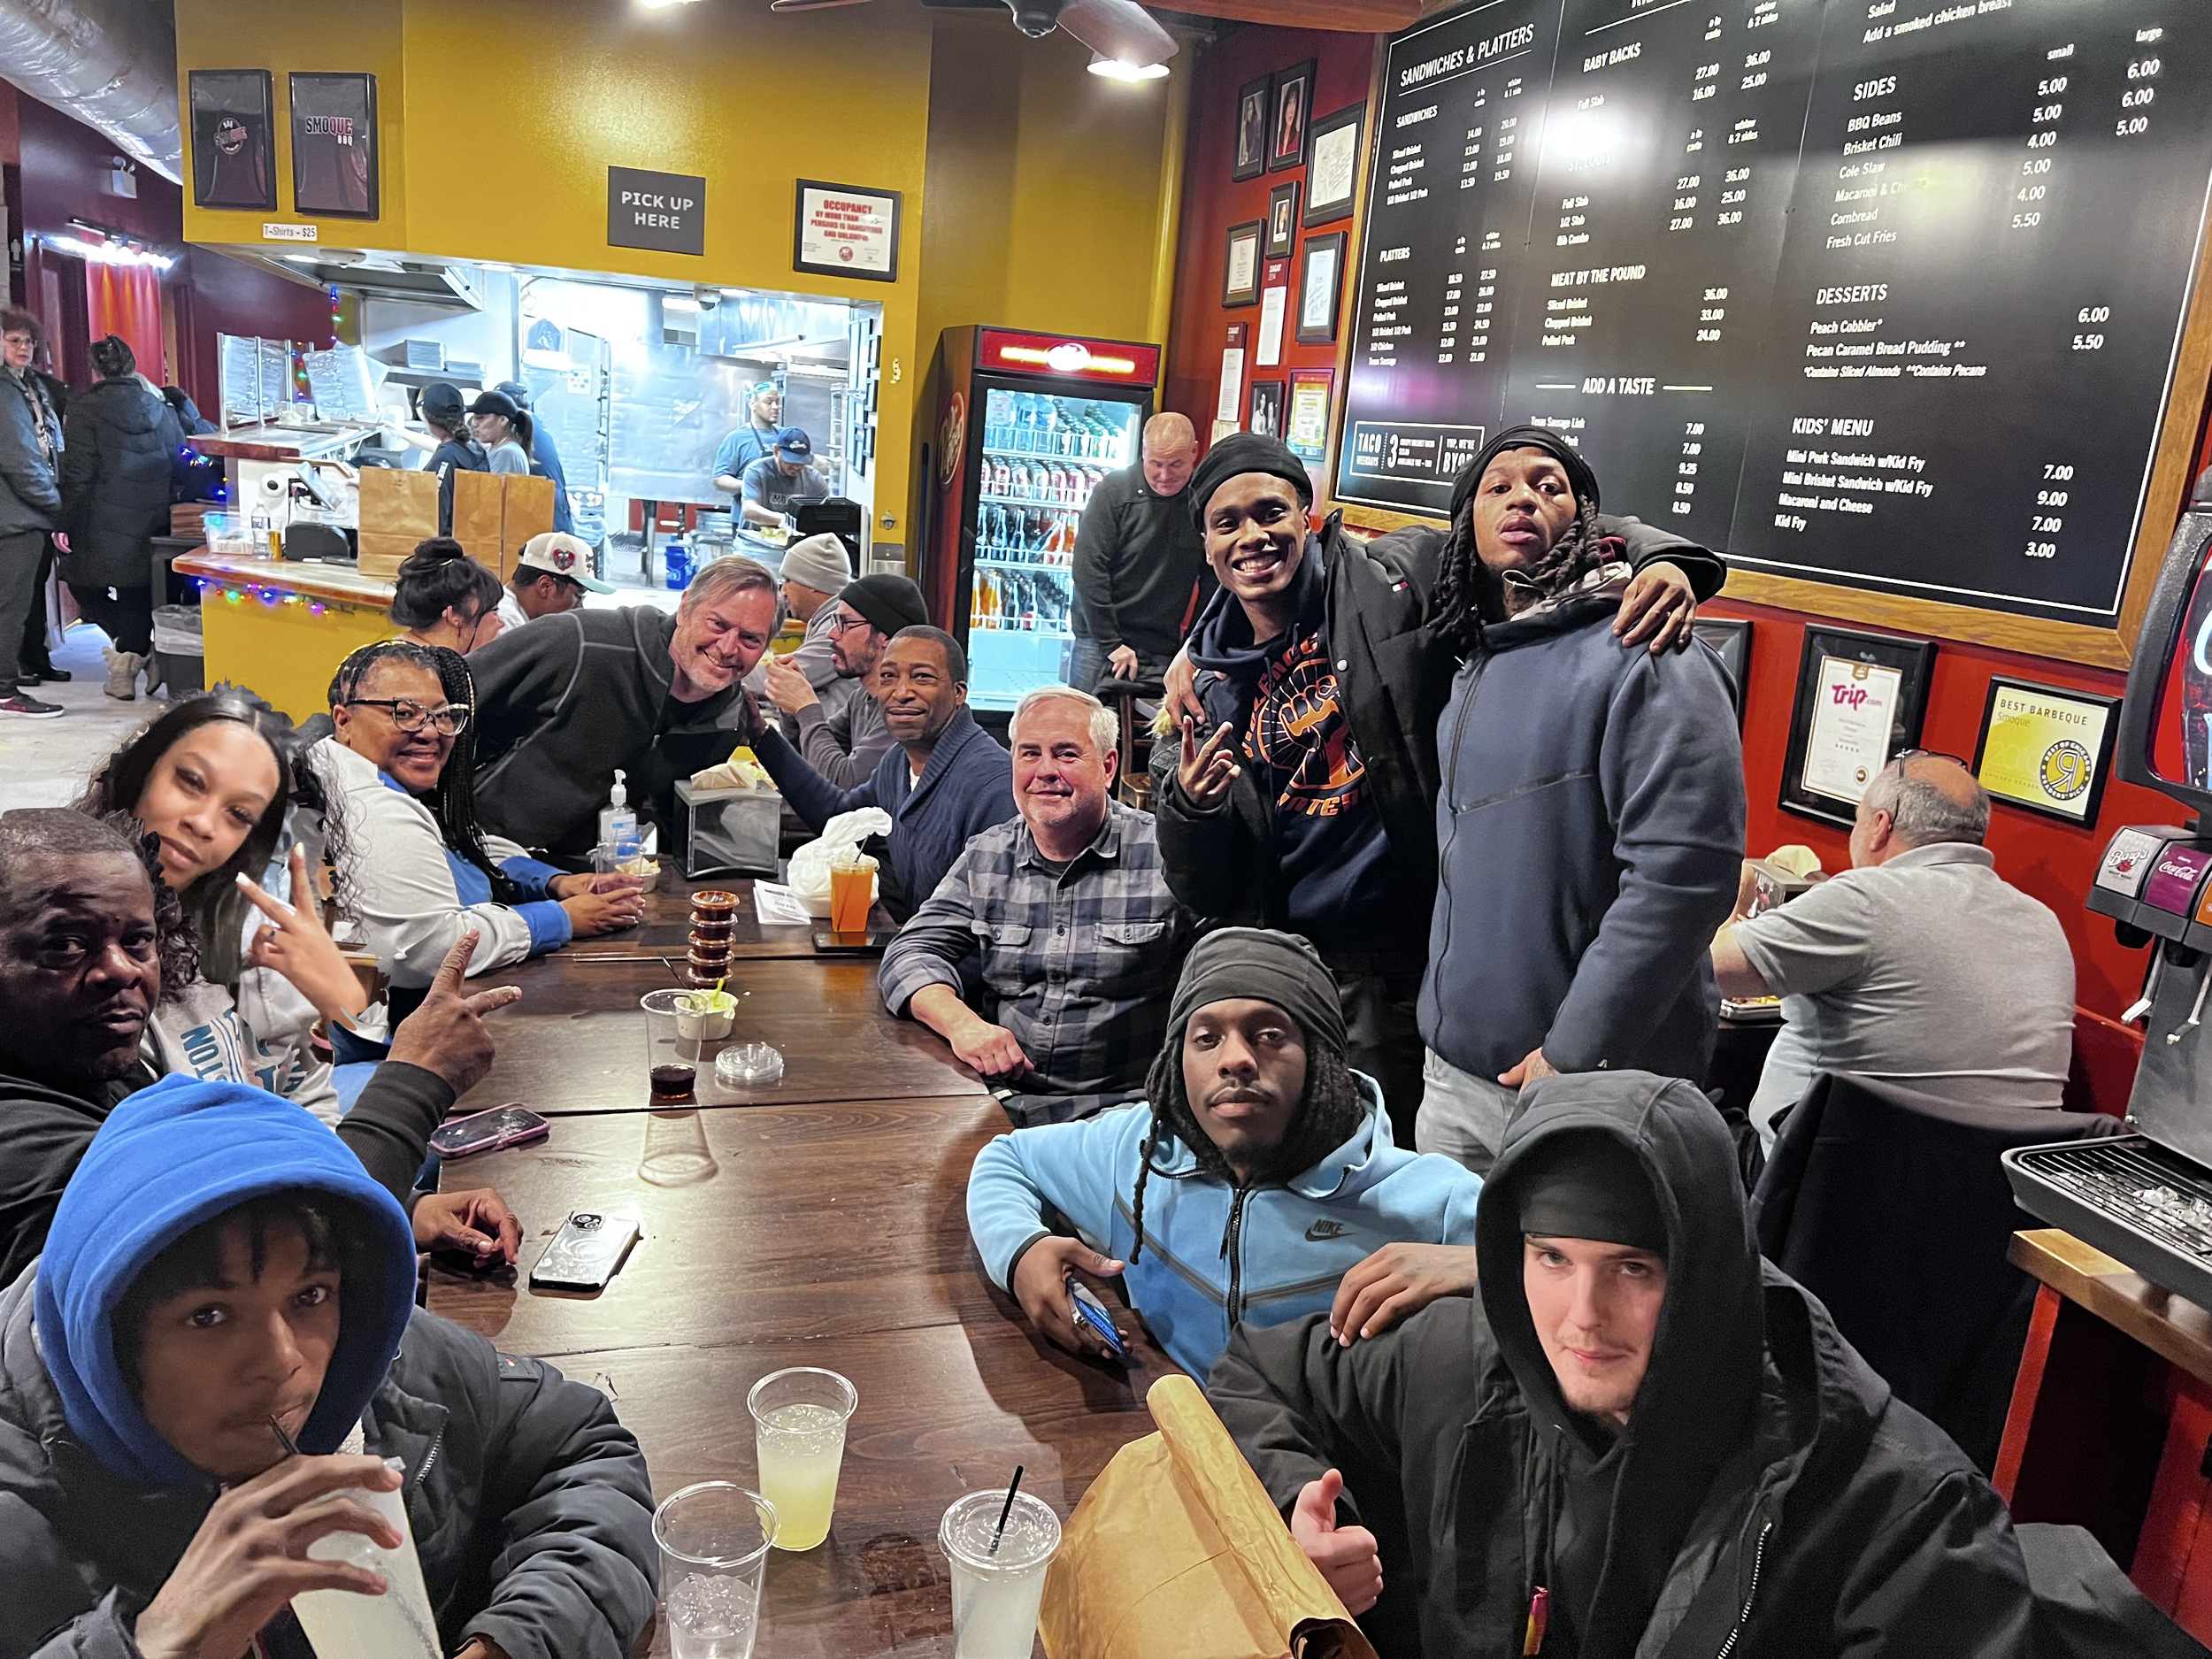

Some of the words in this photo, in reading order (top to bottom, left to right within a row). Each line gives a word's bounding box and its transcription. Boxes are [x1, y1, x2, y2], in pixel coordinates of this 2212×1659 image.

[1867, 0, 1896, 19] Salad
[1863, 26, 1885, 43] Add
[1884, 26, 1892, 38] a
[1893, 12, 1933, 35] smoked
[1933, 4, 1977, 25] chicken
[1978, 0, 2012, 15] breast
[2135, 27, 2163, 42] large
[1400, 50, 1464, 87] SANDWICHES
[1466, 45, 1475, 64] &
[1477, 23, 1534, 60] PLATTERS
[1583, 52, 1609, 73] BABY
[1609, 42, 1642, 65] BACKS
[1744, 50, 1771, 68] 36.00
[2047, 42, 2075, 60] small
[1694, 63, 1720, 81] 27.00
[2127, 58, 2161, 80] 6.00
[1740, 73, 1767, 90] 25.00
[1853, 74, 1897, 102] SIDES
[2038, 76, 2068, 96] 5.00
[1692, 84, 1716, 102] 16.00
[2121, 88, 2154, 108] 6.00
[1396, 105, 1438, 128] SANDWICHES
[1847, 116, 1870, 133] BBQ
[1871, 111, 1902, 128] Beans
[2032, 104, 2062, 123] 5.00
[305, 116, 353, 136] SMOQUE
[2116, 116, 2148, 136] 5.00
[337, 134, 353, 146] BBQ
[1843, 137, 1878, 157] Brisket
[1878, 132, 1903, 150] Chili
[2027, 131, 2057, 149] 4.00
[1568, 158, 1583, 172] ST.
[1584, 151, 1611, 168] LOUIS
[2022, 158, 2052, 176] 5.00
[1724, 167, 1750, 183] 36.00
[1839, 165, 1860, 180] Cole
[1862, 161, 1886, 175] Slaw
[1676, 175, 1700, 190] 27.00
[621, 190, 664, 209] PICK
[670, 196, 694, 211] UP
[1721, 189, 1746, 204] 25.00
[1834, 185, 1878, 203] Macaroni
[1879, 183, 1887, 196] &
[2016, 185, 2046, 202] 4.00
[823, 199, 872, 214] OCCUPANCY
[1562, 197, 1575, 210] Full
[1575, 196, 1589, 209] Slab
[1673, 196, 1696, 211] 16.00
[634, 211, 680, 230] HERE
[825, 211, 841, 220] MORE
[843, 213, 859, 222] THAN
[1670, 217, 1693, 231] 27.00
[1717, 211, 1742, 226] 36.00
[1830, 207, 1879, 227] Cornbread
[2011, 212, 2041, 228] 5.50
[264, 225, 294, 237] T-Shirts
[303, 227, 316, 237] $25
[810, 219, 838, 229] PERSONS
[847, 223, 883, 234] DANGEROUS
[837, 232, 869, 242] UNLAWFUL
[1556, 235, 1567, 246] Rib
[1568, 233, 1590, 245] Combo
[1825, 235, 1852, 250] Fresh
[1854, 232, 1871, 246] Cut
[1872, 229, 1897, 244] Fries
[1379, 247, 1411, 262] PLATTERS
[1551, 272, 1576, 288] MEAT
[1576, 270, 1590, 286] BY
[1590, 267, 1610, 284] THE
[1610, 265, 1646, 281] POUND
[1703, 288, 1728, 301] 36.00
[1816, 283, 1888, 305] DESSERTS
[1700, 309, 1724, 321] 33.00
[2078, 306, 2109, 323] 6.00
[1696, 329, 1721, 342] 24.00
[1810, 321, 1839, 334] Peach
[1806, 344, 1834, 357] Pecan
[1835, 342, 1875, 356] Caramel
[1876, 342, 1905, 355] Bread
[1907, 340, 1951, 357] Pudding
[2072, 334, 2104, 349] 5.50
[1839, 365, 1865, 377] Sliced
[1864, 365, 1901, 377] Almonds
[1952, 364, 1987, 377] Pecans
[1582, 377, 1605, 394] ADD
[1607, 378, 1616, 394] A
[1618, 377, 1655, 396] TASTE
[1686, 422, 1705, 435] 7.00
[1831, 419, 1874, 436] MENU
[1358, 433, 1382, 454] TACO
[1386, 434, 1399, 468] 3
[1682, 442, 1701, 456] 7.00
[1678, 462, 1698, 475] 9.25
[1786, 449, 1808, 464] Mini
[1808, 450, 1829, 465] Pork
[1830, 451, 1876, 468] Sandwich
[1878, 454, 1907, 469] w/Kid
[1907, 456, 1926, 473] Fry
[2042, 464, 2074, 480] 7.00
[1675, 481, 1694, 495] 8.50
[1782, 471, 1803, 485] Mini
[1803, 472, 1836, 488] Brisket
[1837, 475, 1883, 491] Sandwich
[1885, 479, 1915, 494] w/Kid
[1915, 480, 1934, 498] Fry
[1778, 493, 1819, 509] Macaroni
[1819, 497, 1838, 511] and
[1839, 498, 1874, 514] Cheese
[2036, 490, 2068, 507] 9.00
[1672, 501, 1692, 514] 8.50
[1774, 514, 1791, 527] Kid
[1792, 515, 1807, 532] Fry
[2032, 516, 2062, 533] 7.00
[2024, 541, 2056, 558] 3.00
[1832, 683, 1882, 711] Trip.com
[1997, 711, 2031, 727] Smoque
[2000, 699, 2026, 712] BEST
[2030, 705, 2088, 726] BARBEQUE
[2044, 744, 2060, 761] BEST
[2070, 741, 2091, 772] CHICAGO
[2108, 849, 2149, 869] Barq's
[1312, 1219, 1344, 1235] NIKE
